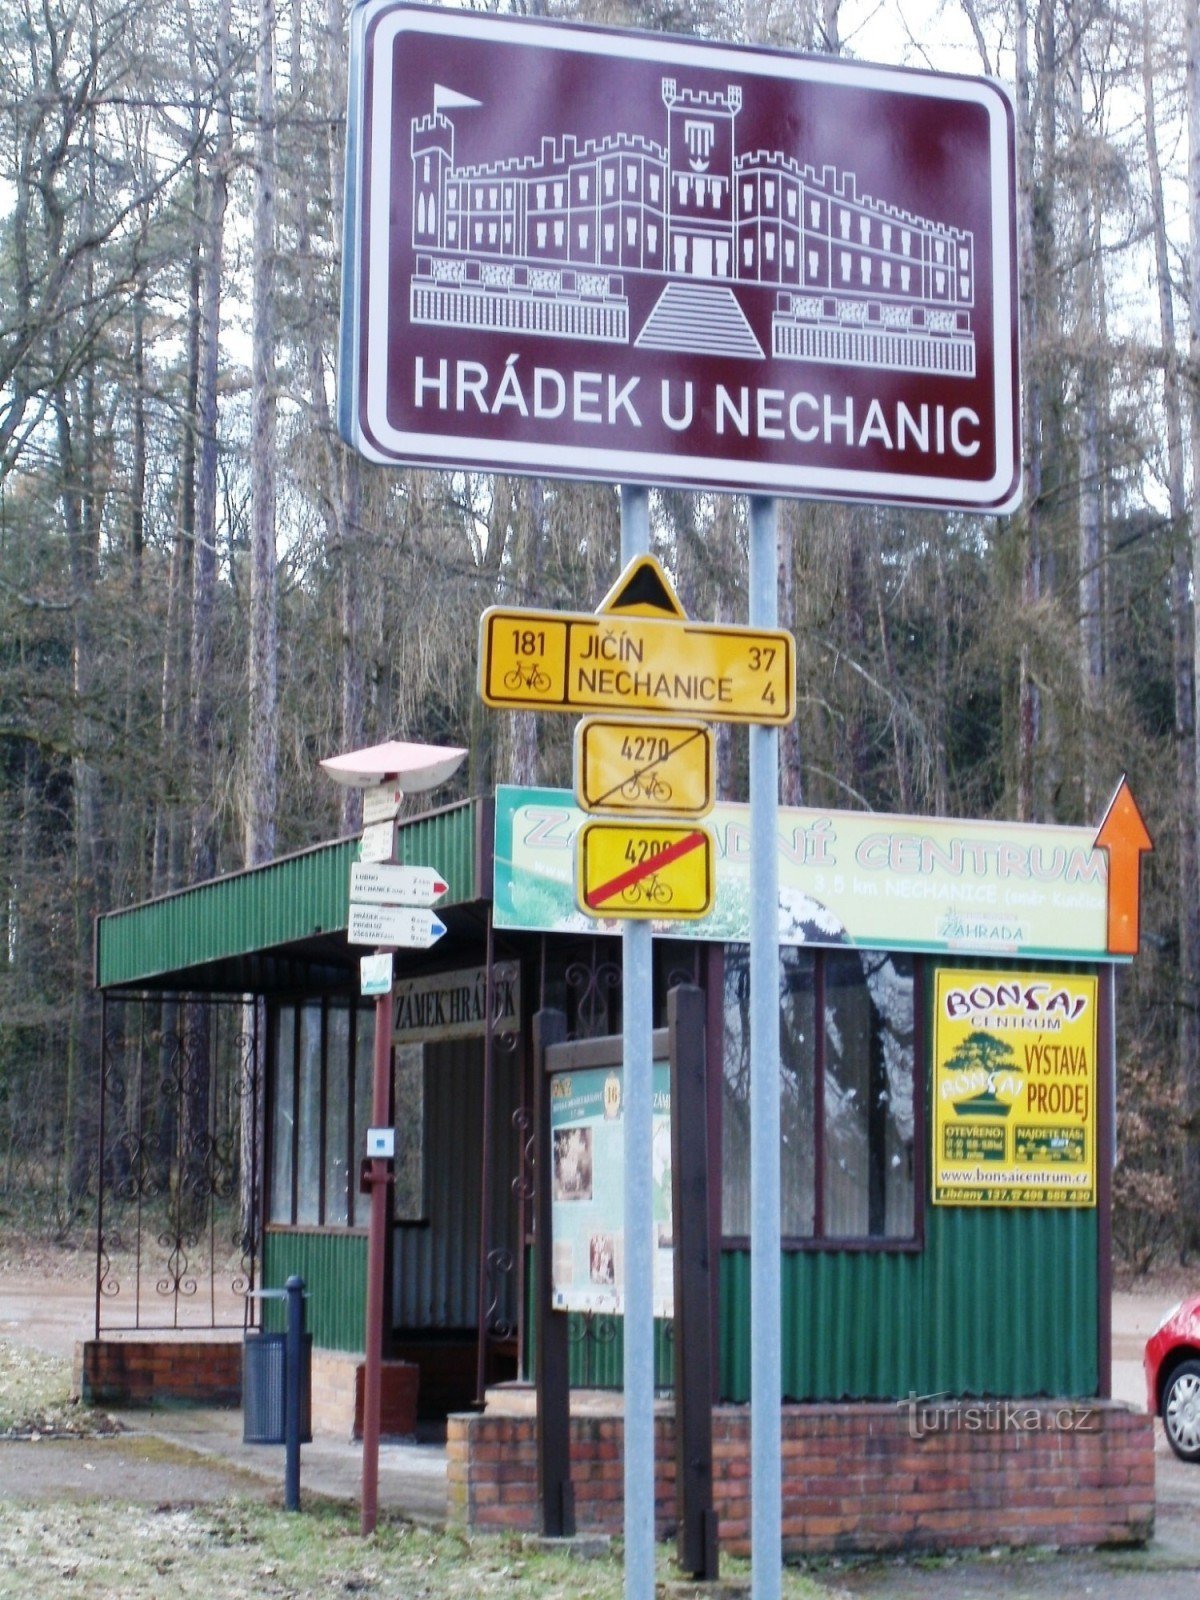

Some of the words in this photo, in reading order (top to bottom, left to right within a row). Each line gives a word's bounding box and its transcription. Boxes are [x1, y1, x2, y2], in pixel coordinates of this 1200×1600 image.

[413, 353, 643, 428] HRÁDEK
[661, 379, 695, 431] U
[715, 383, 981, 458] NECHANIC
[512, 630, 546, 657] 181
[579, 630, 645, 663] JIČÍN
[748, 647, 777, 673] 37
[577, 668, 734, 704] NECHANICE
[761, 682, 776, 706] 4
[621, 736, 670, 762] 4270
[856, 832, 1108, 884] CENTRUM
[886, 879, 997, 904] NECHANICE
[942, 921, 1025, 942] ZAHRADA
[396, 981, 448, 1030] ZÁMEK
[945, 983, 1087, 1020] BONSAI
[971, 1014, 1062, 1030] CENTRUM
[1024, 1034, 1089, 1076] VÝSTAVA
[1026, 1082, 1090, 1122] PRODEJ
[941, 1167, 1088, 1185] www.bonsaicentrum.cz
